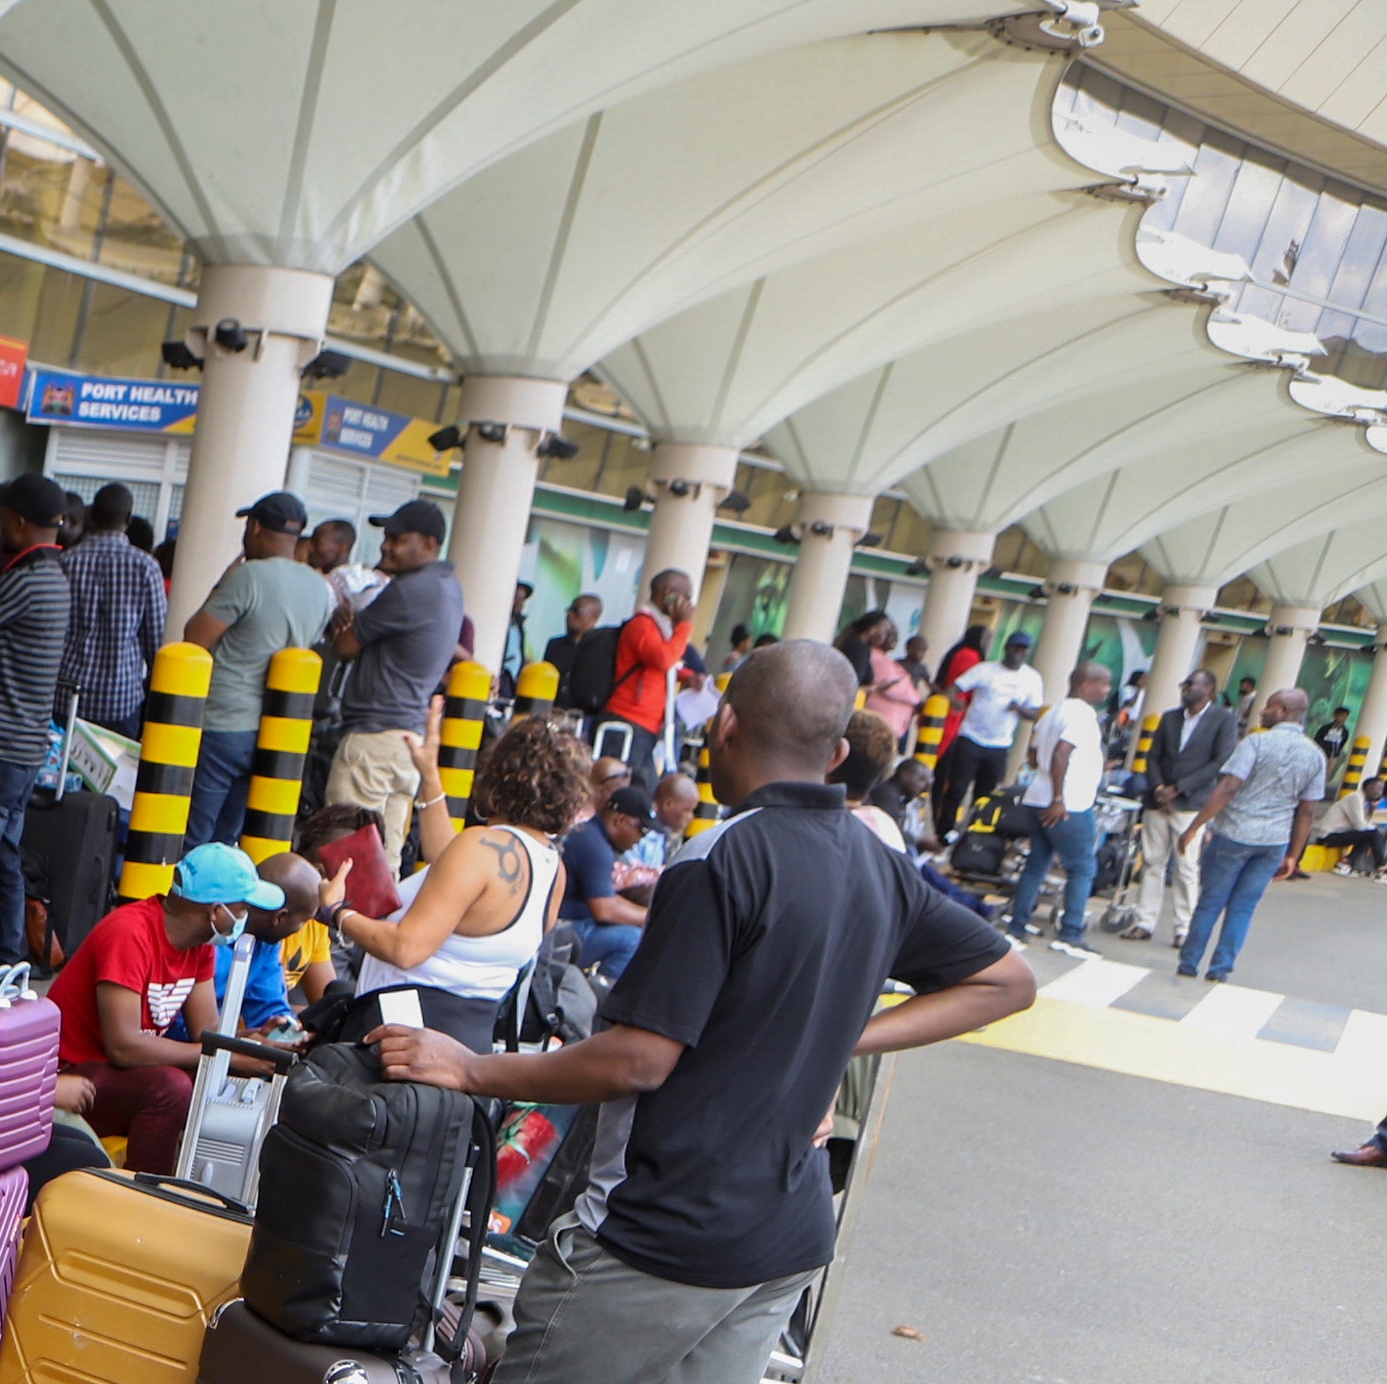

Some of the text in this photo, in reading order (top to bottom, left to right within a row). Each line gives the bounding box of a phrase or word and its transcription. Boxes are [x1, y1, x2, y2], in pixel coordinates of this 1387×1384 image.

[81, 382, 198, 405] PORT HEALTH
[78, 401, 161, 423] SERVICES
